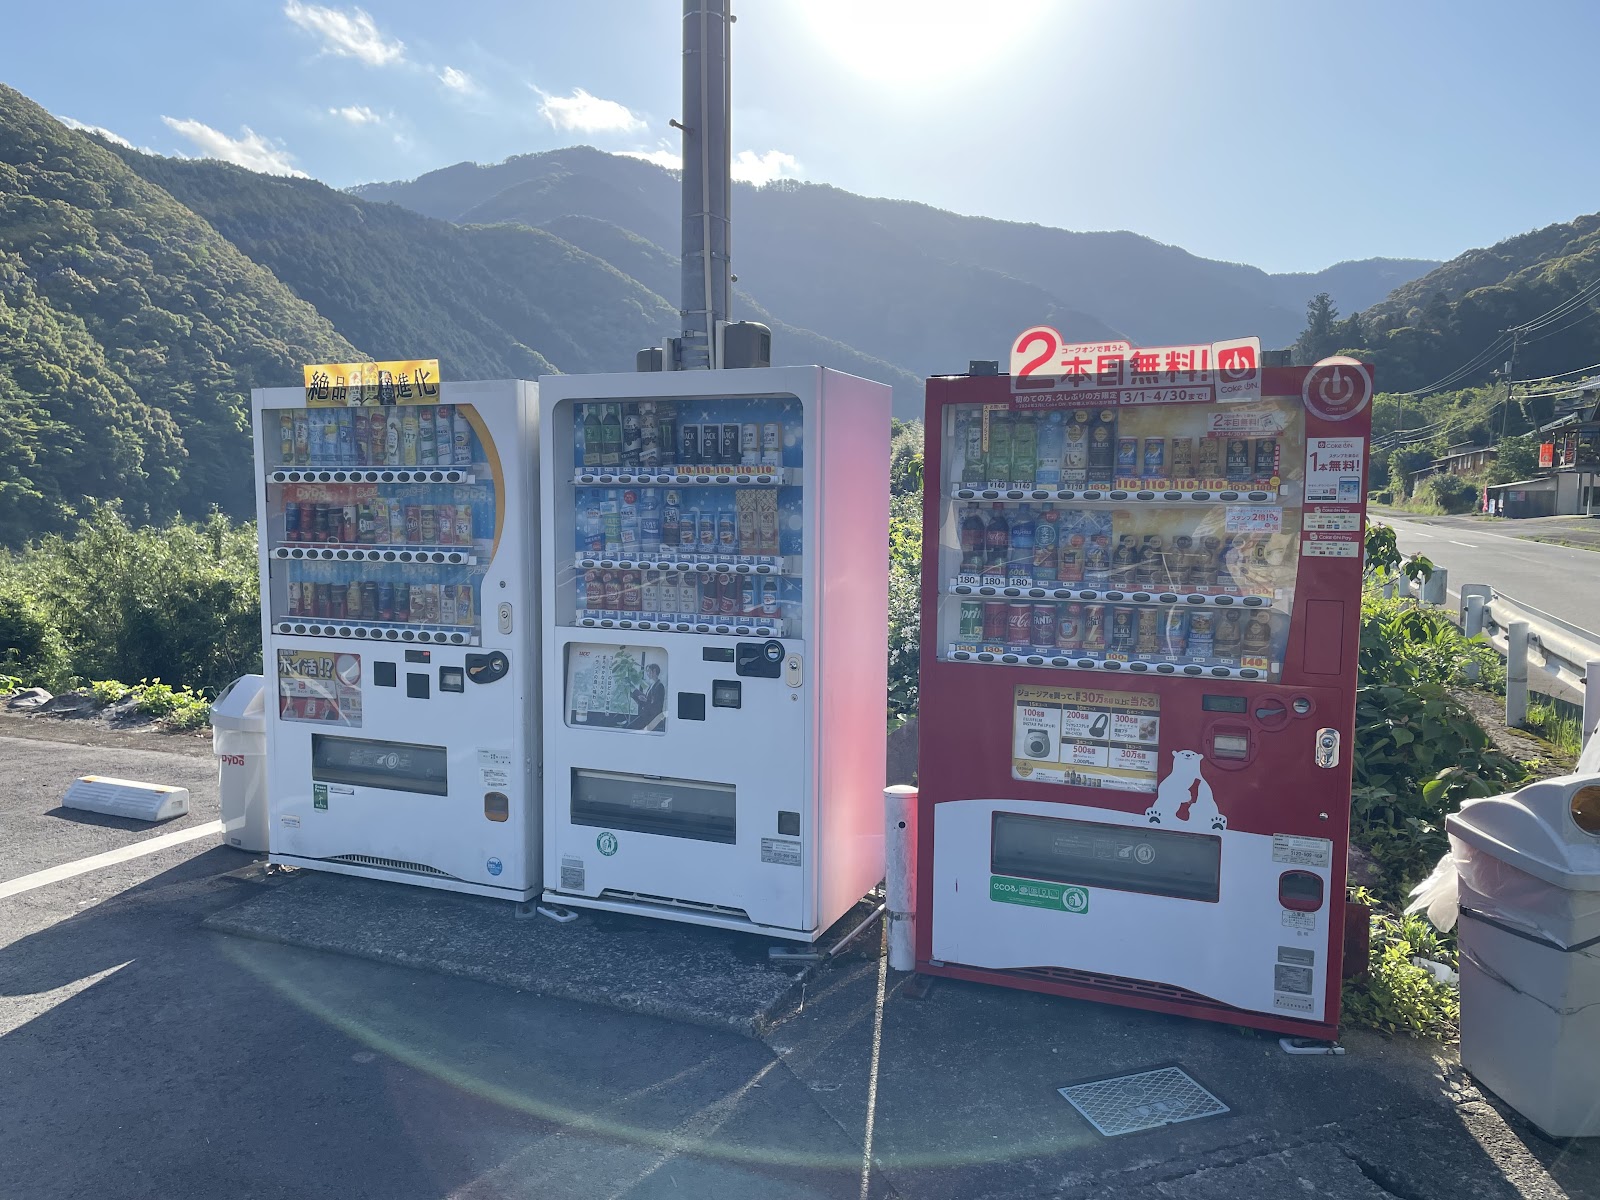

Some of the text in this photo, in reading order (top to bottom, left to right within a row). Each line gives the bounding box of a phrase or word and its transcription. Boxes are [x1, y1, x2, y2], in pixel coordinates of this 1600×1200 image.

[1016, 331, 1208, 390] 2本目無料!
[1220, 385, 1243, 394] Coke
[1015, 391, 1118, 403] 初めての方、久しぶりの方限定
[1310, 452, 1360, 472] 1本無料!
[1039, 526, 1050, 544] 麦茶
[1033, 615, 1053, 625] FANTA
[1023, 708, 1045, 718] 100名様
[1066, 711, 1089, 720] 200名様
[1115, 715, 1138, 724] 300名様
[1073, 746, 1096, 755] 500名様
[1121, 750, 1146, 760] 30万名様
[221, 755, 245, 766] DyDo
